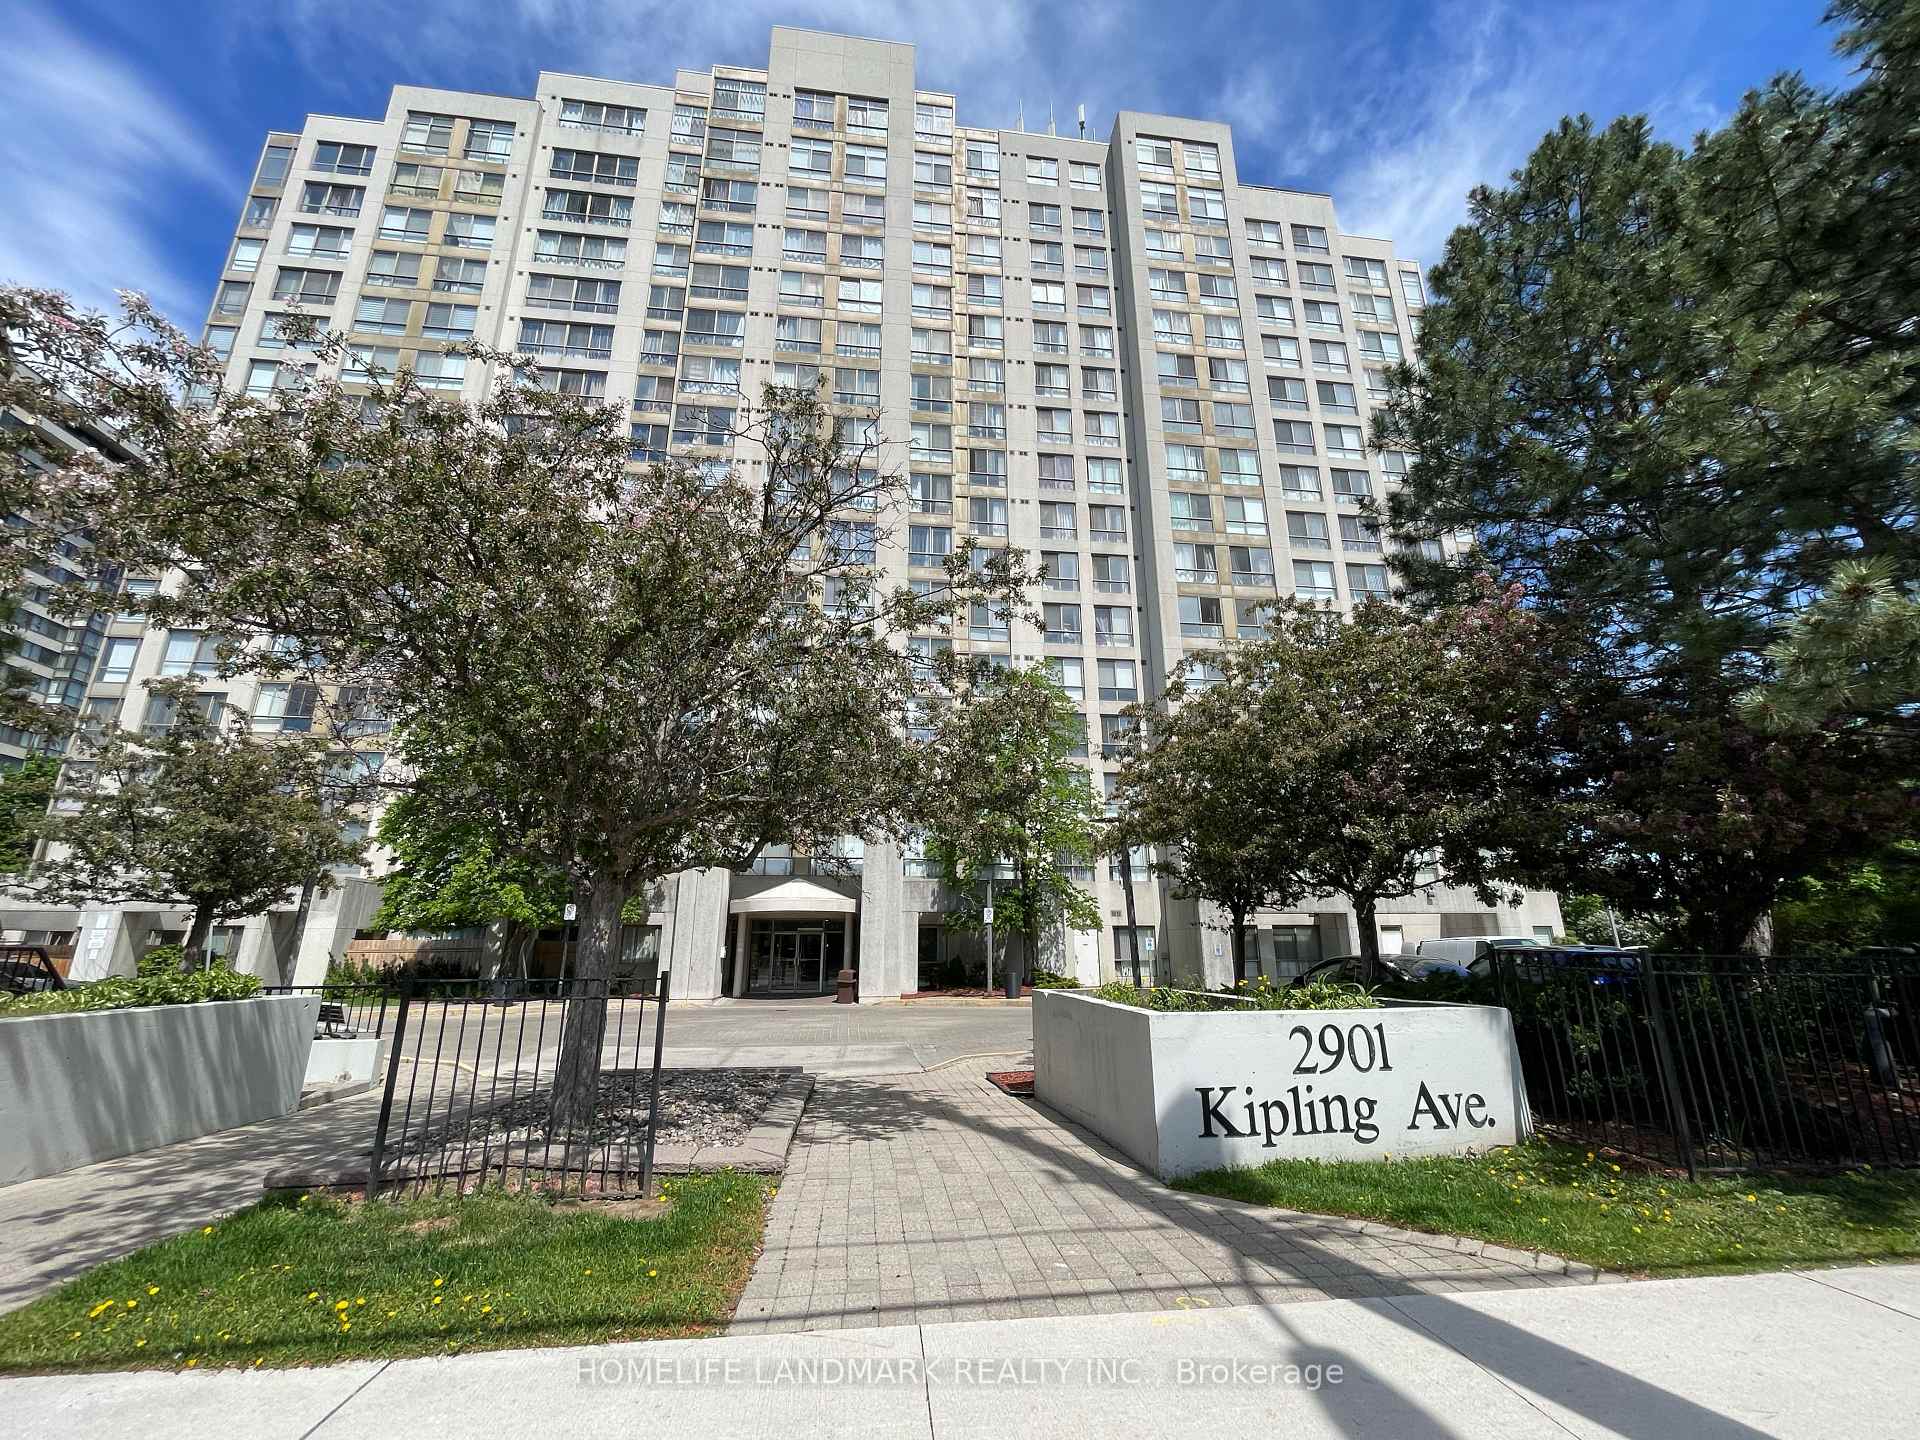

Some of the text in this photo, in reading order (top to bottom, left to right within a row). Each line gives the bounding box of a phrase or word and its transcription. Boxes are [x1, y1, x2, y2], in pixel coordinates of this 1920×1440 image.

[1288, 1023, 1393, 1075] 2901
[1195, 1080, 1496, 1147] Kipling Ave.
